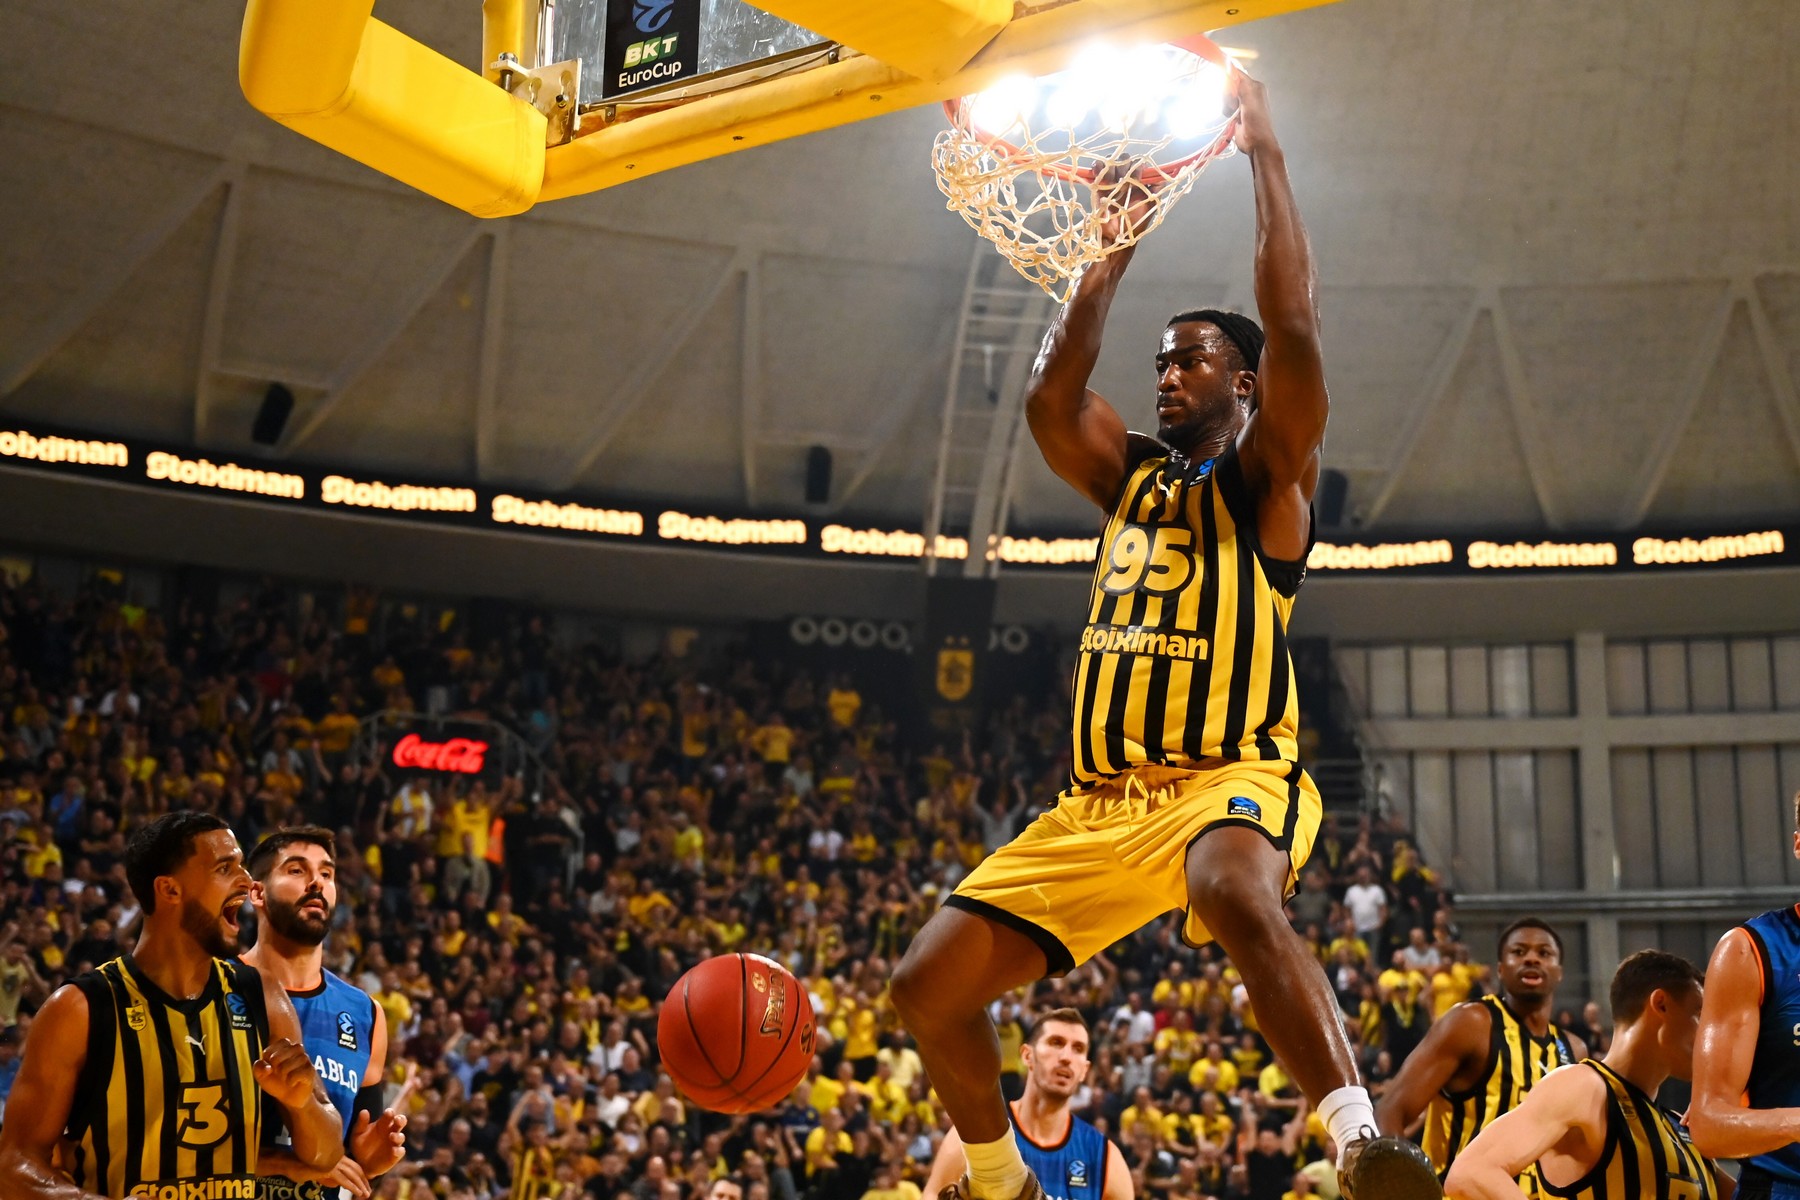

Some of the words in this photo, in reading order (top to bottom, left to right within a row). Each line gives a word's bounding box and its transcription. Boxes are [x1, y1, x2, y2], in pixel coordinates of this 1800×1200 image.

[625, 36, 678, 64] BKT
[618, 61, 682, 88] EuroCup
[1103, 526, 1191, 593] 95
[1079, 625, 1209, 661] Stoiximan
[181, 1085, 229, 1145] 3
